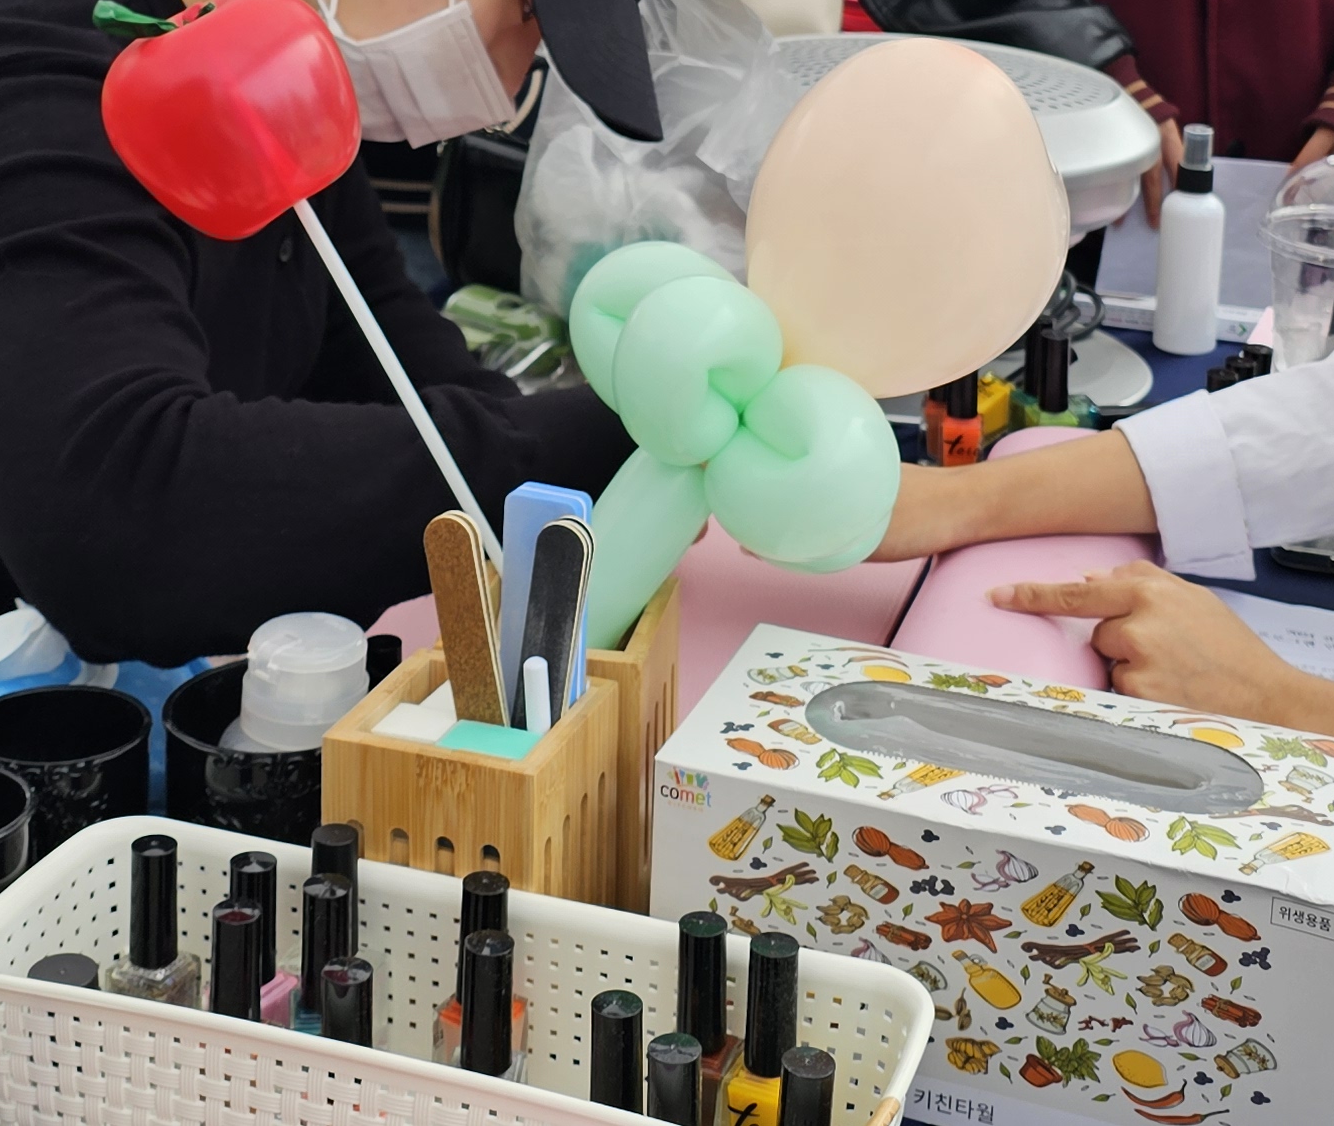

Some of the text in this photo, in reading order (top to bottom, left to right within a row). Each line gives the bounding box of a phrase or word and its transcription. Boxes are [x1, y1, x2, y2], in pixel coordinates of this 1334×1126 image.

[660, 784, 712, 809] comet
[1278, 905, 1332, 932] 위생용품
[913, 1087, 995, 1126] 키친타월
